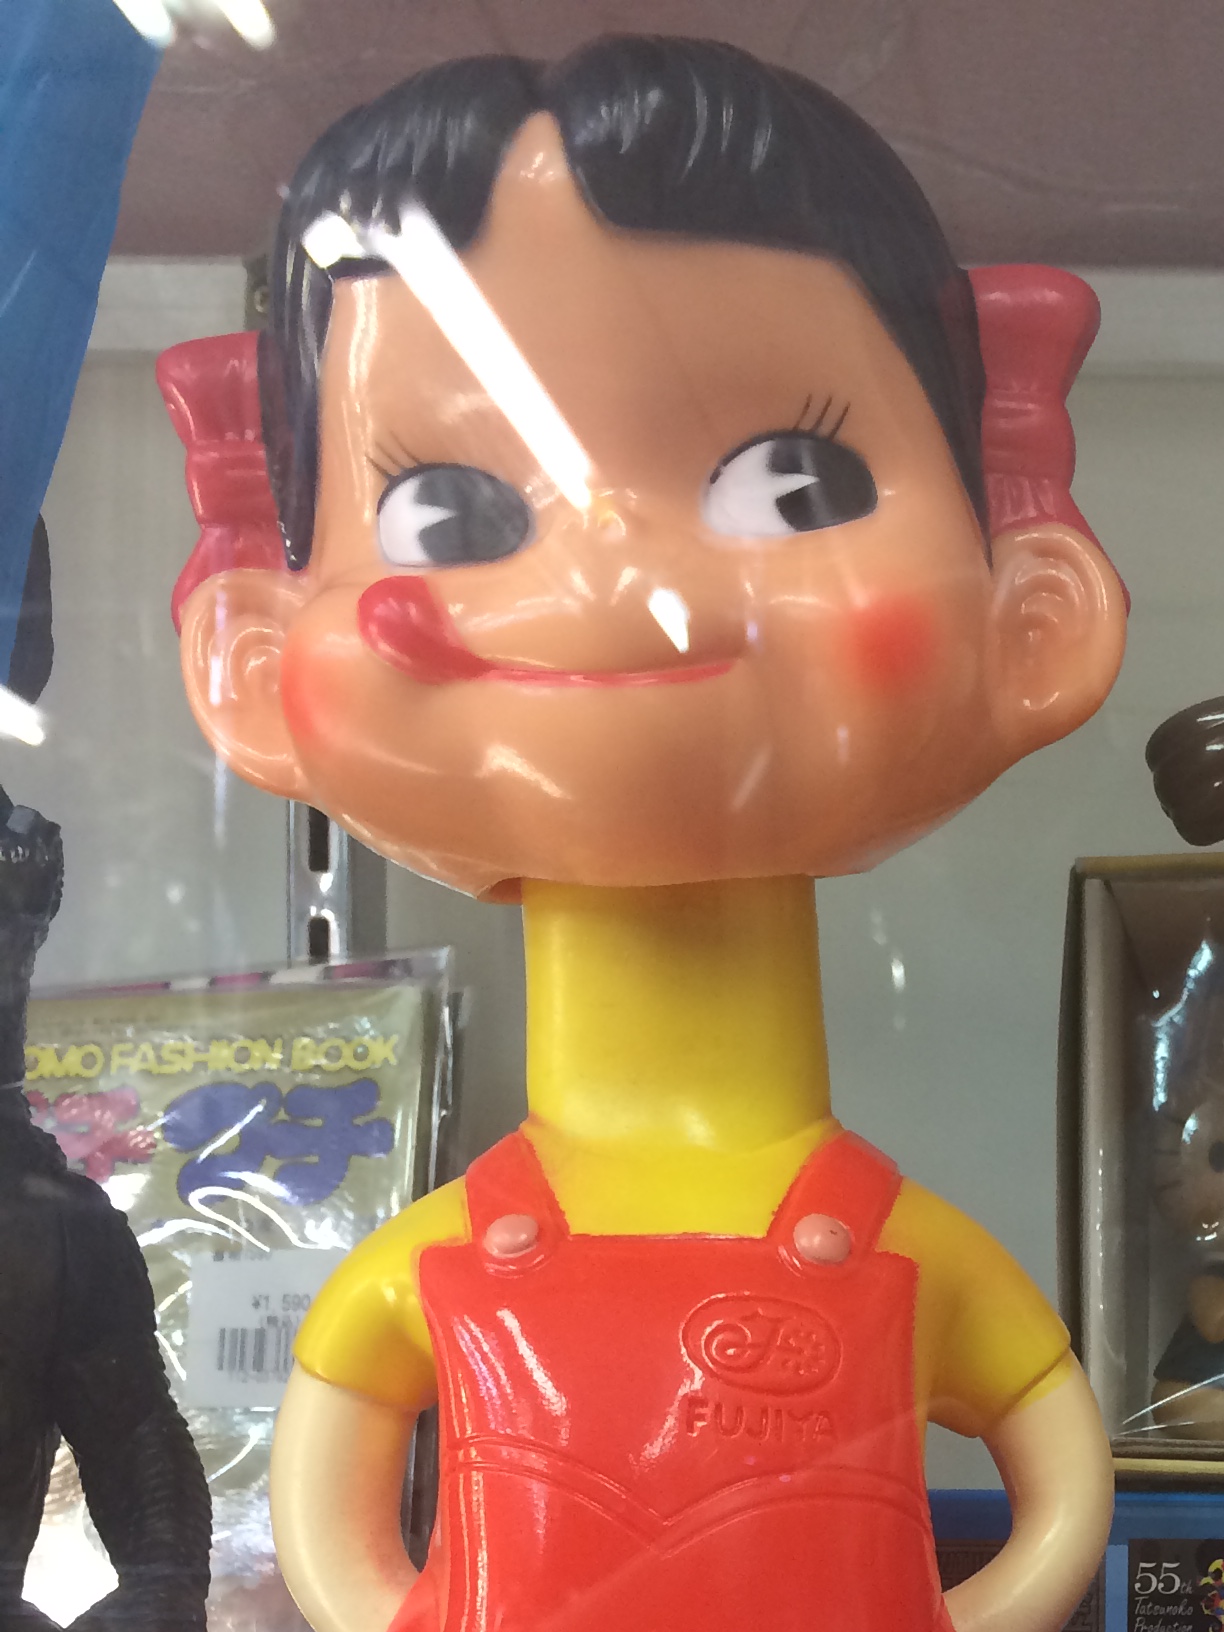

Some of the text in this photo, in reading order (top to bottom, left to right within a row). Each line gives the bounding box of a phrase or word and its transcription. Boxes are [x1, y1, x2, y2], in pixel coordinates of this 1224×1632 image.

[110, 1038, 284, 1076] FASHION
[290, 1033, 399, 1073] BOOK
[685, 1396, 838, 1443] FUJIYA
[1134, 1561, 1193, 1595] 55th
[1134, 1596, 1194, 1616] Tatsunoko
